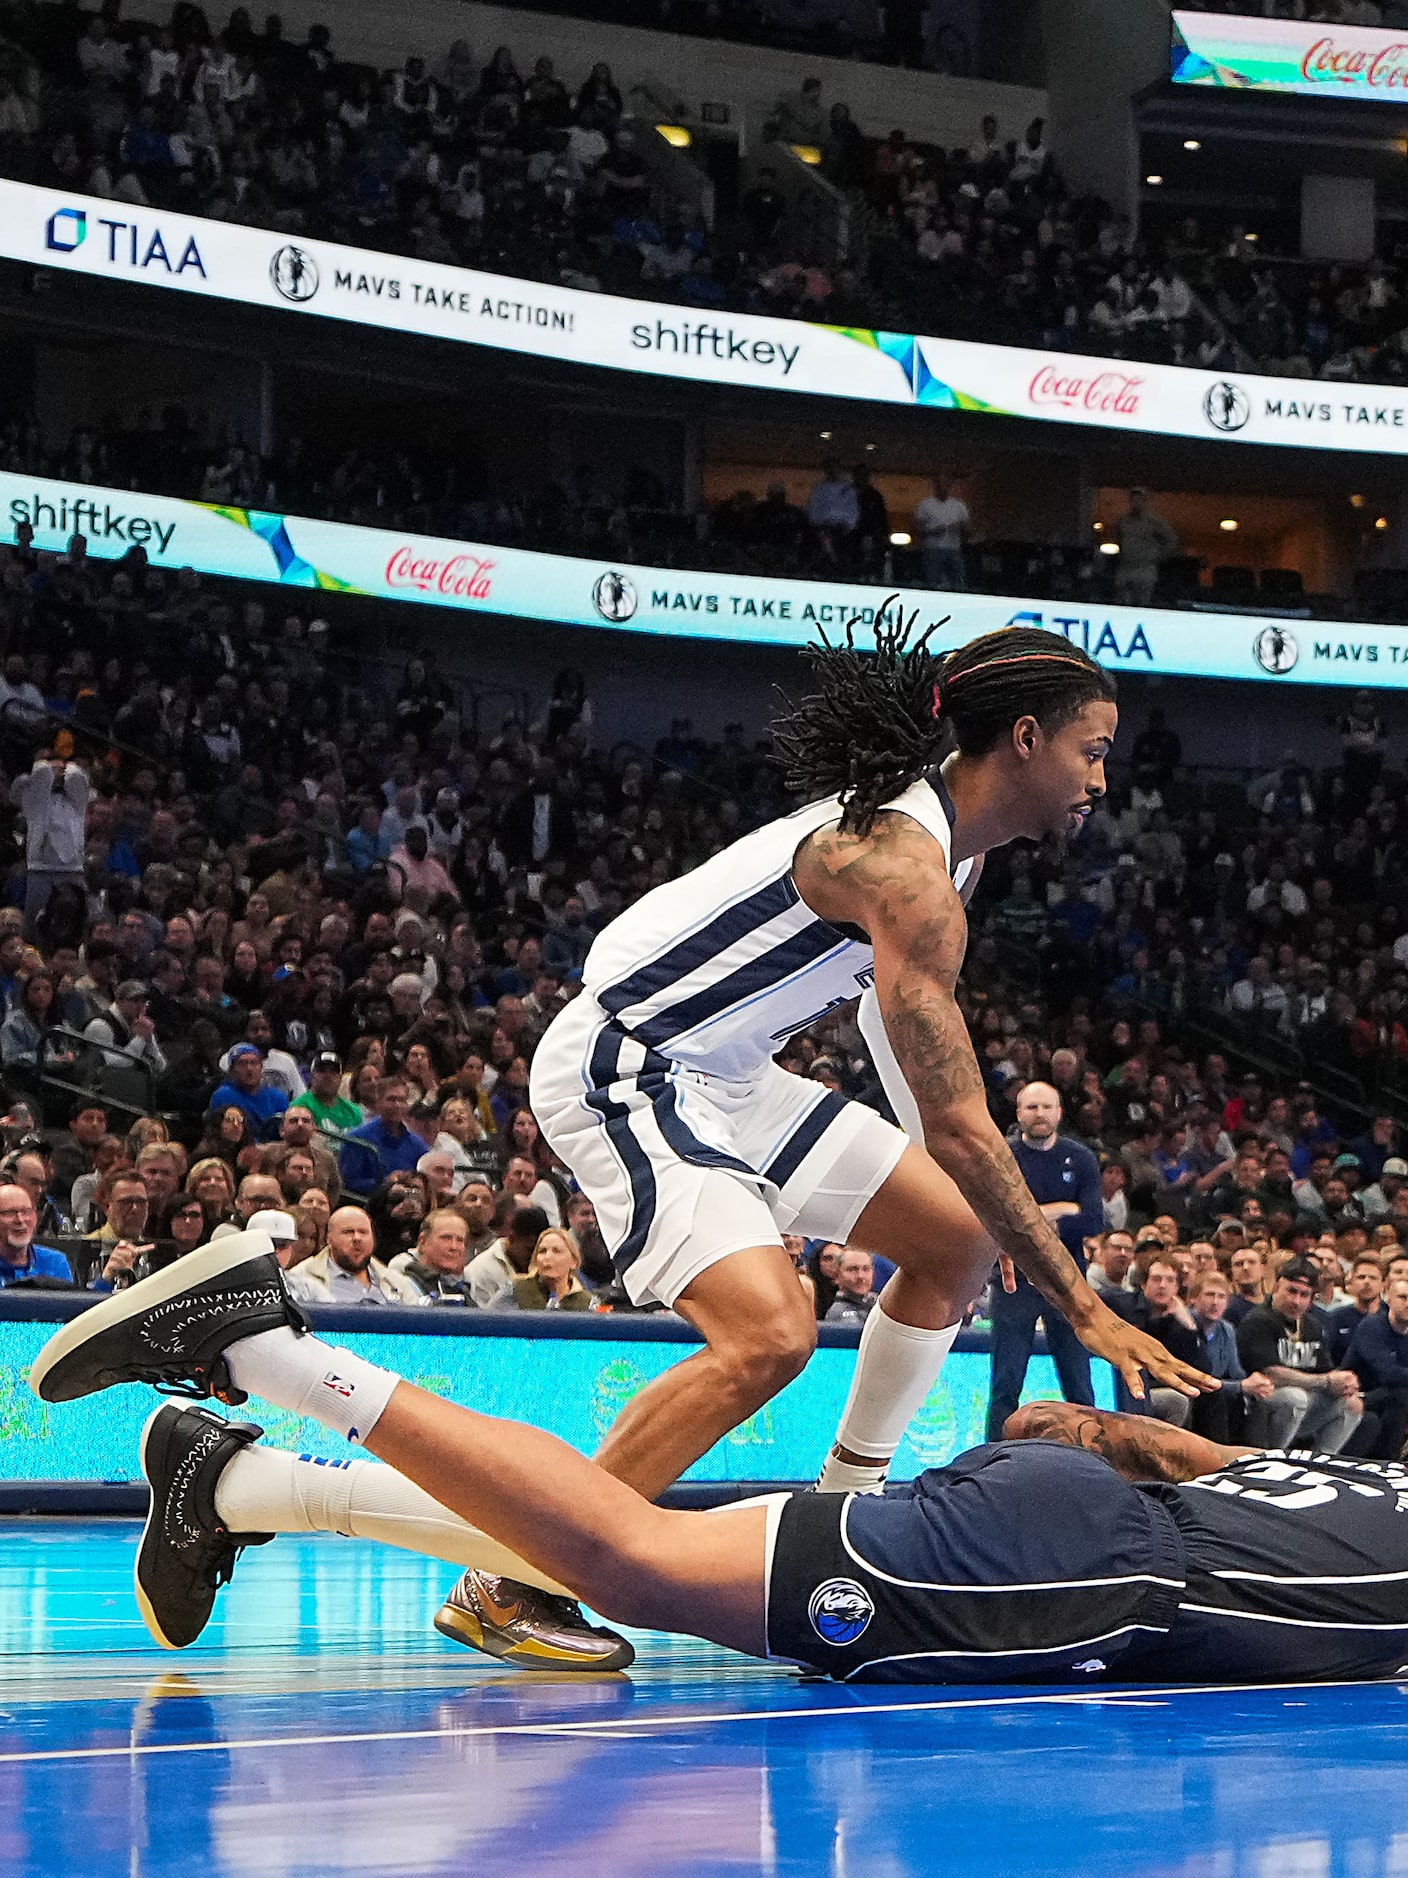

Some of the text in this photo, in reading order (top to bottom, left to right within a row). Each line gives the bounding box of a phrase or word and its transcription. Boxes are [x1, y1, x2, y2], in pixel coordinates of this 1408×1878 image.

[99, 217, 207, 279] TIAA
[334, 270, 574, 331] MAVS TAKE ACTION!
[632, 319, 800, 376] shiftkey
[1265, 400, 1331, 422] MAVS
[1343, 405, 1404, 427] TAKE
[10, 495, 176, 555] shiftkey
[651, 590, 719, 614] MAVS
[730, 597, 792, 620] TAKE
[1053, 617, 1153, 661] TIAA
[1314, 642, 1378, 662] MAVS
